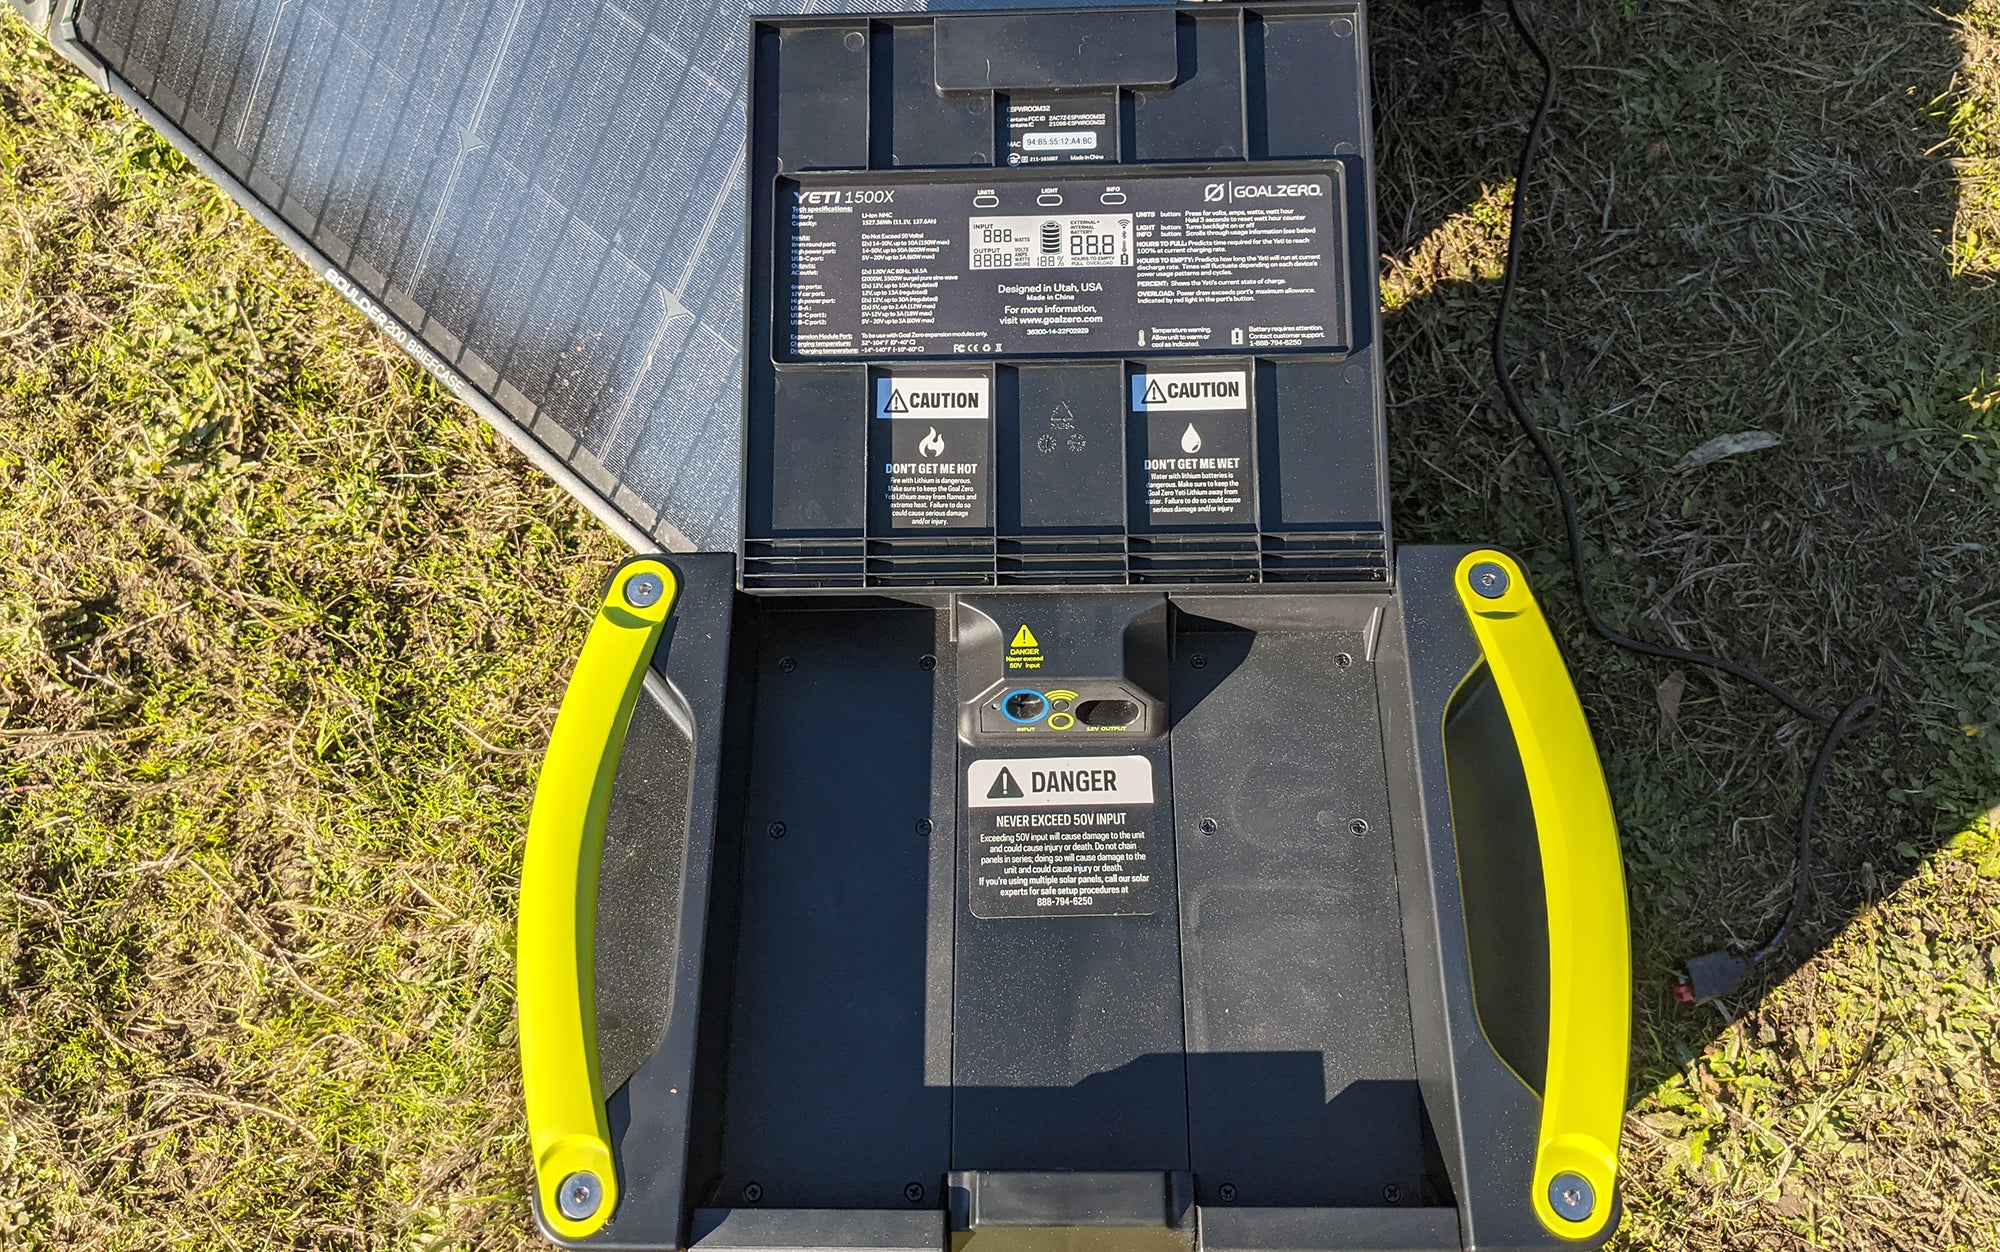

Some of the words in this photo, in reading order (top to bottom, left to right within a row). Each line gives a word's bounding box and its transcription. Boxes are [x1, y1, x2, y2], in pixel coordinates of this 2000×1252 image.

[793, 191, 841, 204] YETI
[845, 191, 895, 203] 1500X
[998, 284, 1042, 294] Designed
[1043, 284, 1051, 292] in
[1054, 284, 1079, 293] Utah,
[1081, 283, 1103, 291] USA
[1044, 305, 1097, 314] information,
[1000, 316, 1018, 324] visit
[1020, 315, 1103, 325] www.goalzero.com
[324, 268, 388, 327] BOULDER
[384, 321, 407, 343] 200
[406, 339, 465, 393] BRIEFCASE
[1167, 382, 1239, 398] CAUTION
[910, 392, 979, 408] CAUTION
[886, 464, 917, 474] DON'T
[918, 464, 938, 474] GET
[940, 464, 955, 474] ME
[957, 464, 977, 474] HOT
[1144, 459, 1176, 470] DON'T
[1178, 459, 1198, 469] GET
[1200, 459, 1216, 469] ME
[1217, 458, 1240, 468] WET
[1031, 770, 1118, 793] DANGER
[996, 815, 1029, 828] NEVER
[1031, 814, 1071, 827] EXCEED
[1073, 813, 1094, 826] 50V
[1096, 813, 1126, 825] INPUT
[980, 834, 1014, 844] Exceeding
[1016, 833, 1030, 842] 50V
[1031, 833, 1048, 842] input
[1082, 832, 1109, 842] damage
[1044, 844, 1063, 853] injury
[981, 856, 1003, 865] panels
[1034, 855, 1053, 864] doing
[1097, 853, 1124, 862] damage
[1073, 865, 1092, 874] injury
[985, 877, 1007, 887] you're
[1009, 877, 1028, 886] using
[1029, 876, 1058, 885] multiple
[1078, 875, 1104, 884] panels,
[1105, 875, 1117, 883] call
[1000, 888, 1028, 896] experts
[1058, 887, 1078, 896] setup
[1080, 886, 1120, 895] procedures
[1037, 897, 1093, 906] 888-794-6250
